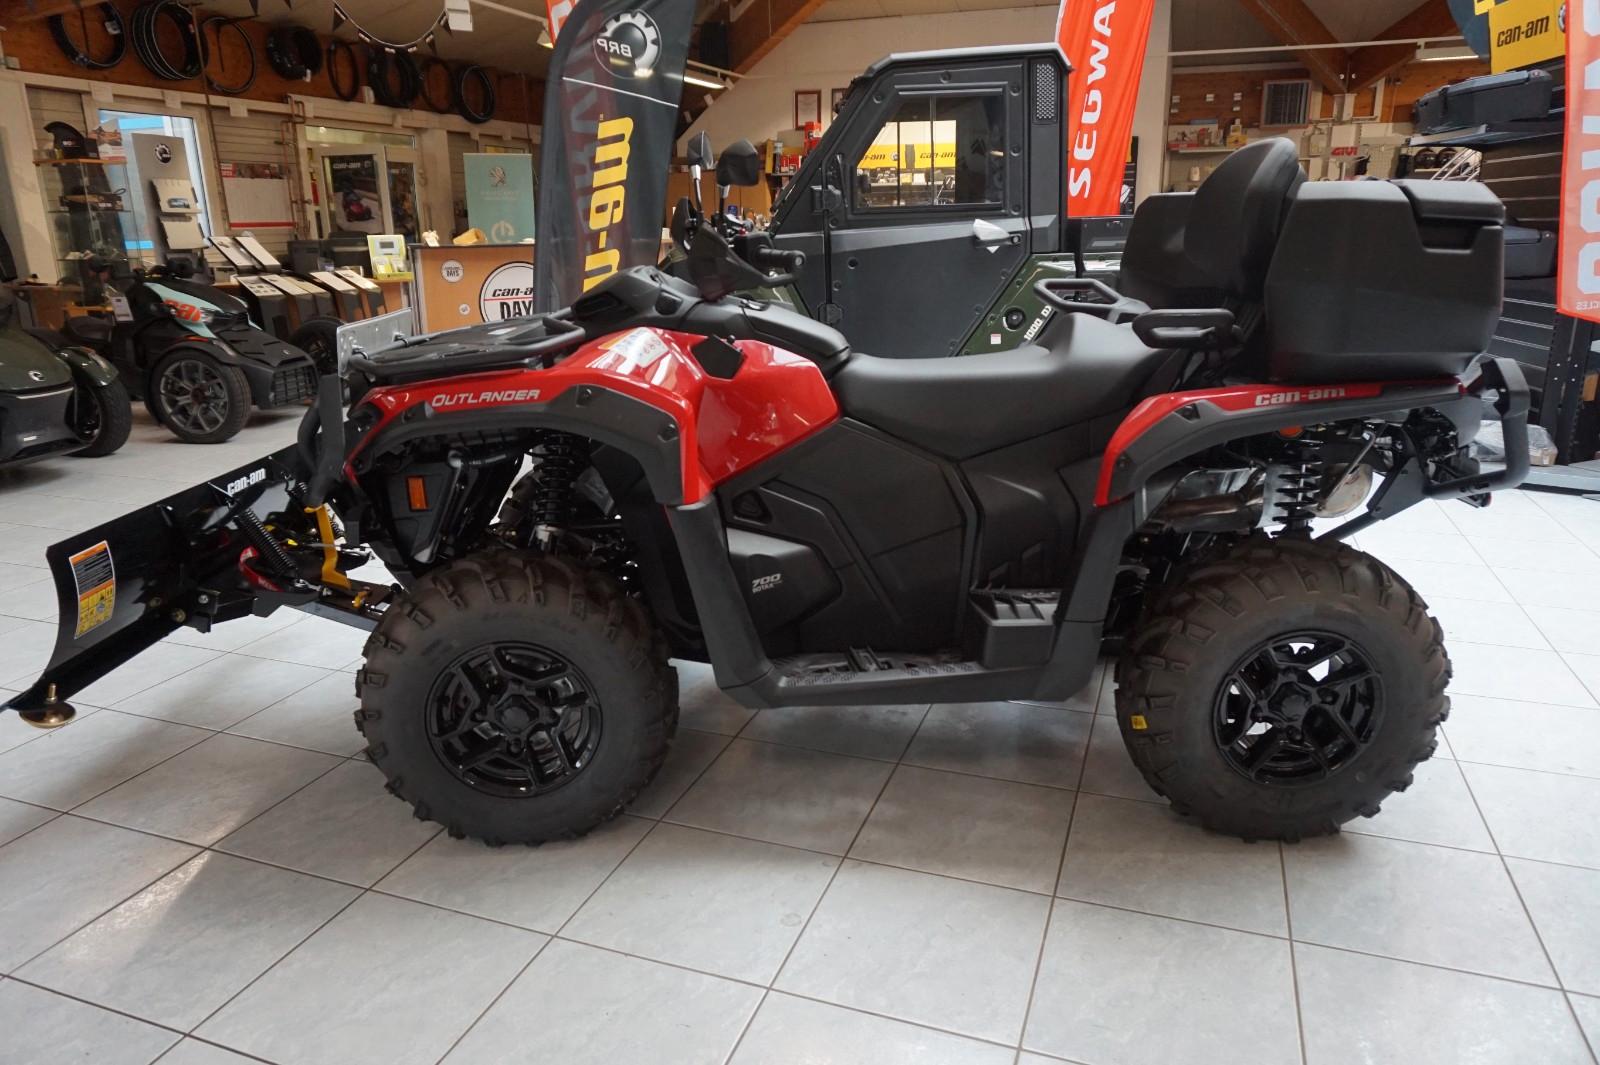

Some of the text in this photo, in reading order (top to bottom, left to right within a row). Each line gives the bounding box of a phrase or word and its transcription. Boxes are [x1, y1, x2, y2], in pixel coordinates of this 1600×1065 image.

[1496, 15, 1549, 48] can-am
[1069, 0, 1117, 199] SEGWA
[1331, 147, 1358, 156] GIVI
[492, 287, 533, 298] can-a
[500, 300, 533, 320] DAY
[1024, 318, 1043, 341] 1000
[431, 389, 541, 407] OUTLANDER
[1255, 387, 1345, 406] can-am
[227, 467, 266, 497] can-am
[751, 573, 782, 588] 700
